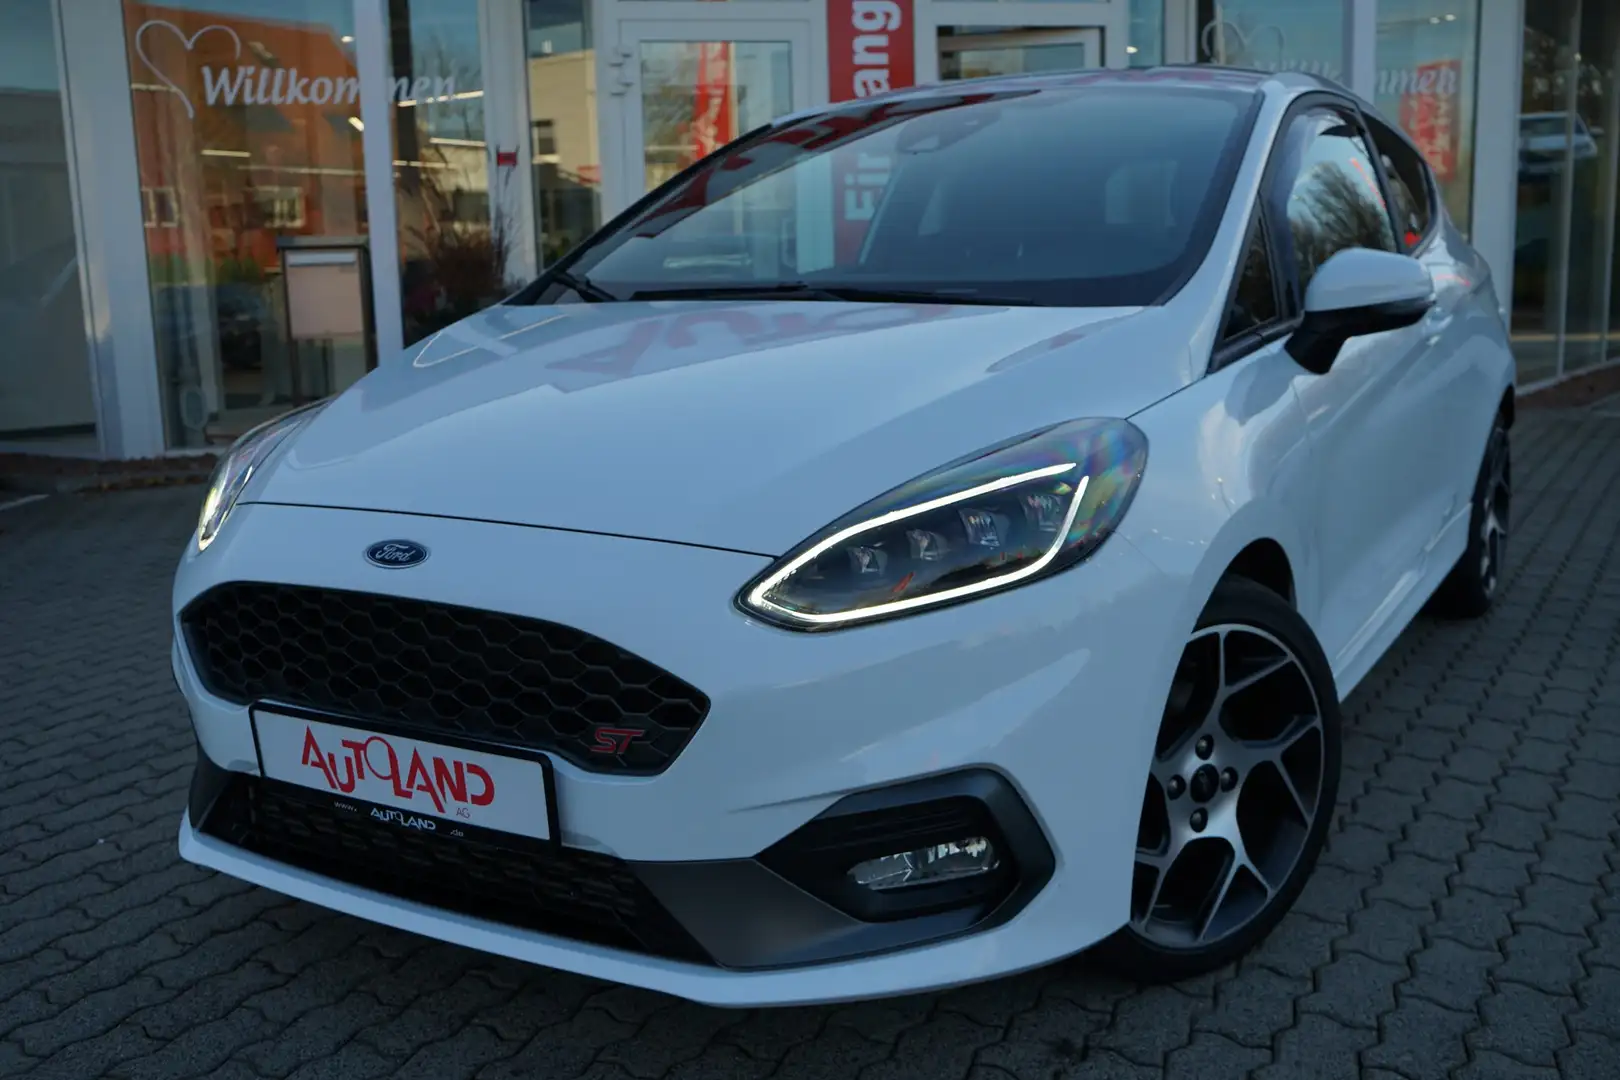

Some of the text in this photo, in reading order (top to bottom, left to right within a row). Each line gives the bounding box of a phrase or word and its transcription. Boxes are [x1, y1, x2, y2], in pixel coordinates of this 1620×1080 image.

[375, 543, 416, 561] Ford
[590, 727, 645, 754] ST
[301, 725, 495, 814] AUTOLAND
[370, 807, 436, 830] AUTOLAND
[455, 807, 471, 819] AG
